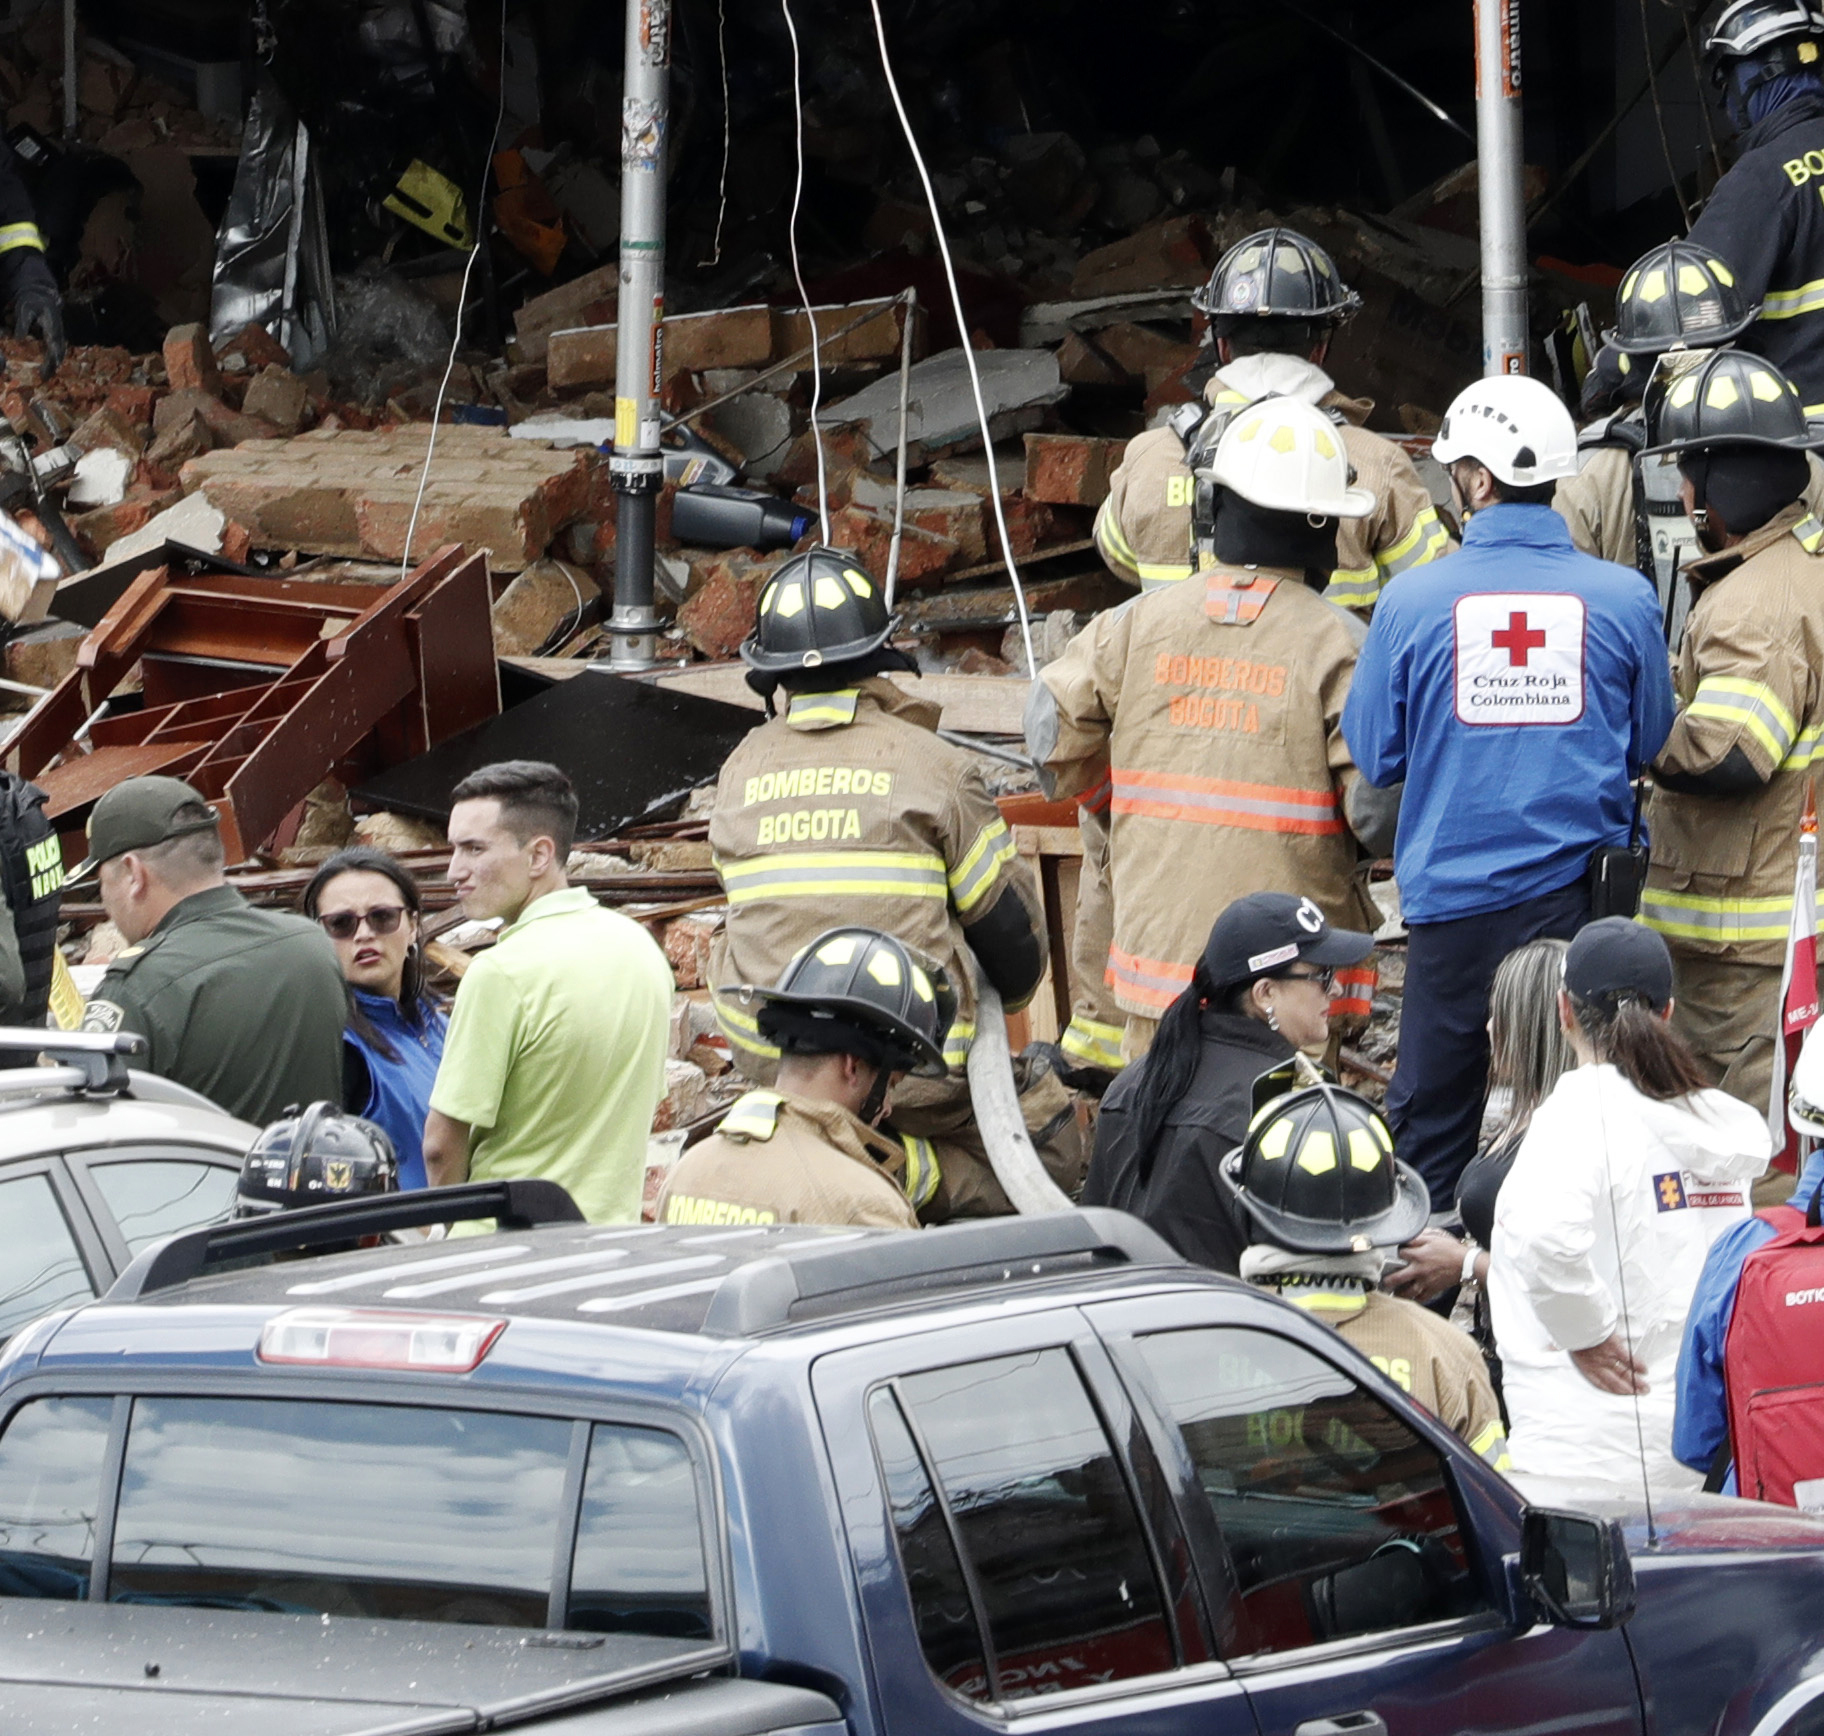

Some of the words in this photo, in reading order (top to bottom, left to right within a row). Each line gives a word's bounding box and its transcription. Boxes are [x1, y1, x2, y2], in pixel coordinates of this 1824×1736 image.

[1154, 652, 1287, 697] BOMBEROS
[1474, 675, 1520, 688] Cruz
[1525, 674, 1567, 690] Roja
[1169, 695, 1260, 734] BOGOTA
[1471, 693, 1570, 707] Colombiana
[743, 767, 892, 807] BOMBEROS
[757, 809, 861, 845] BOGOTA
